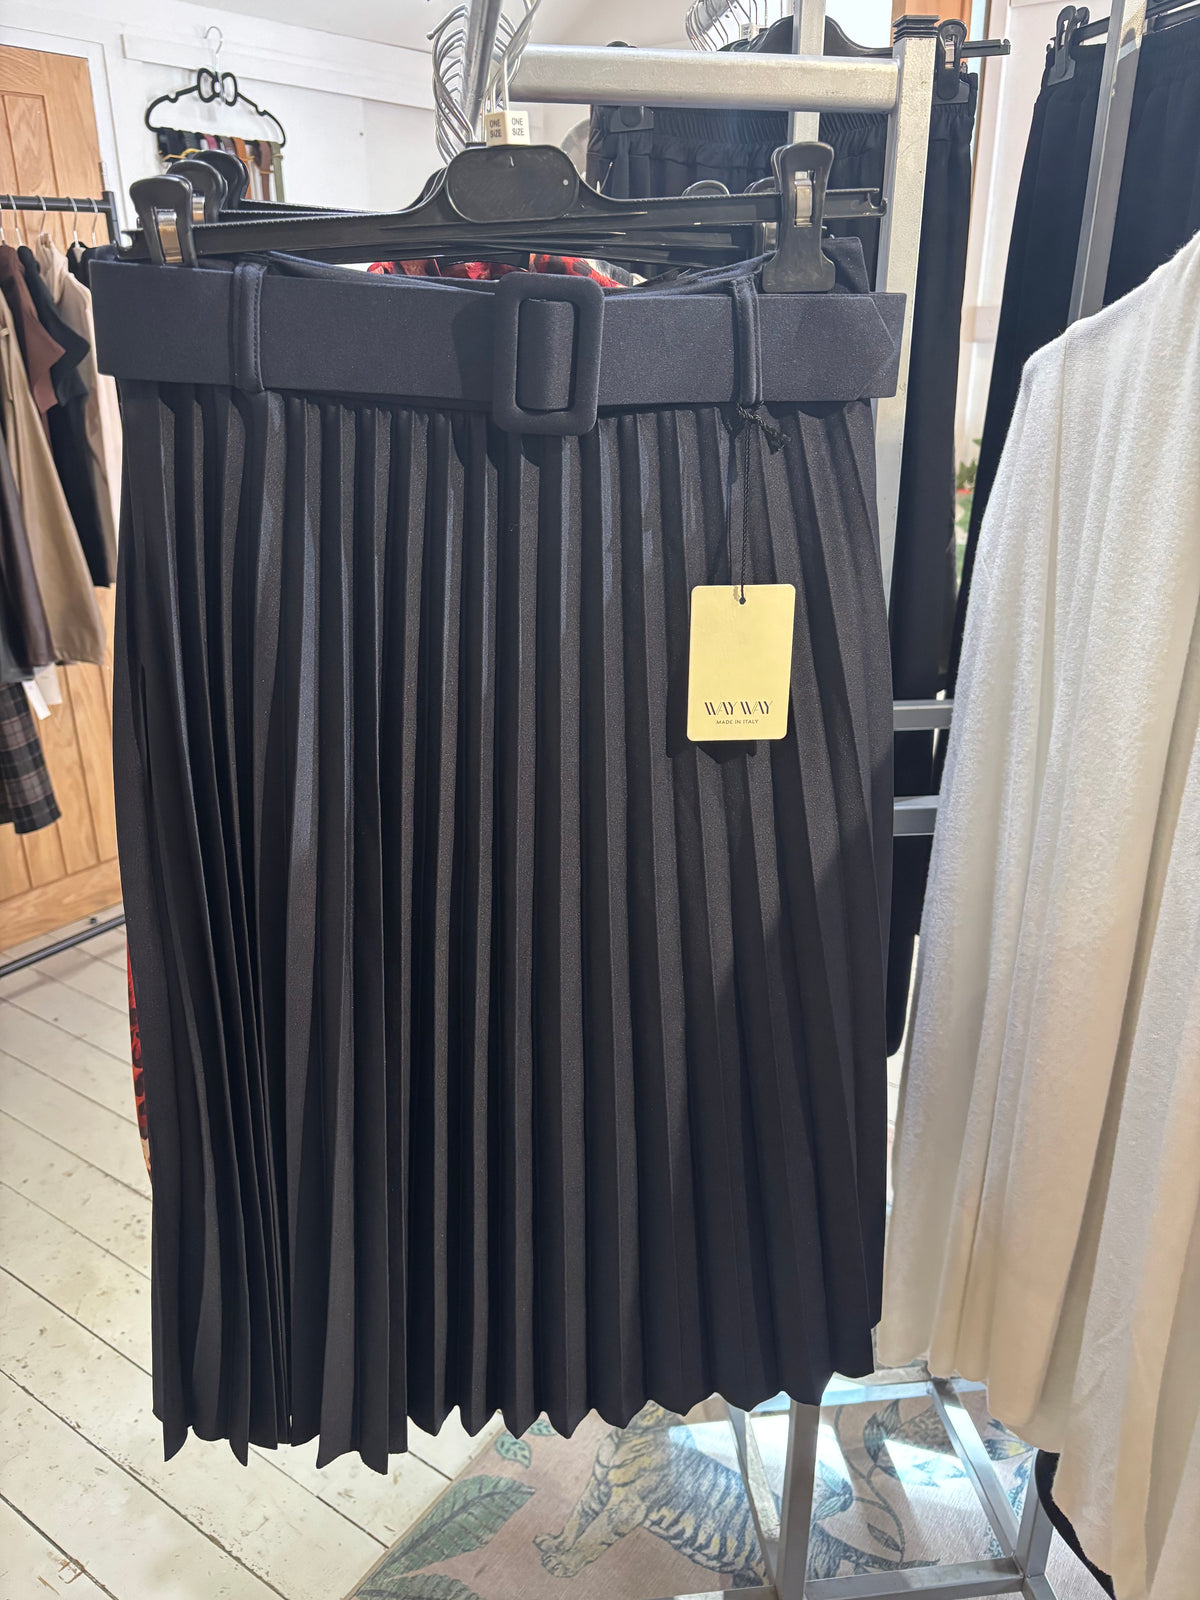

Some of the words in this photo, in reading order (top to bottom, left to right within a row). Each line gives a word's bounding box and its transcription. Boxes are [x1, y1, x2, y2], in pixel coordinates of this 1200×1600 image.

[490, 119, 501, 128] ONE
[511, 117, 523, 126] ONE
[490, 129, 502, 138] SIZE
[512, 127, 525, 136] SIZE
[704, 701, 738, 716] WAY
[740, 700, 774, 715] WAY
